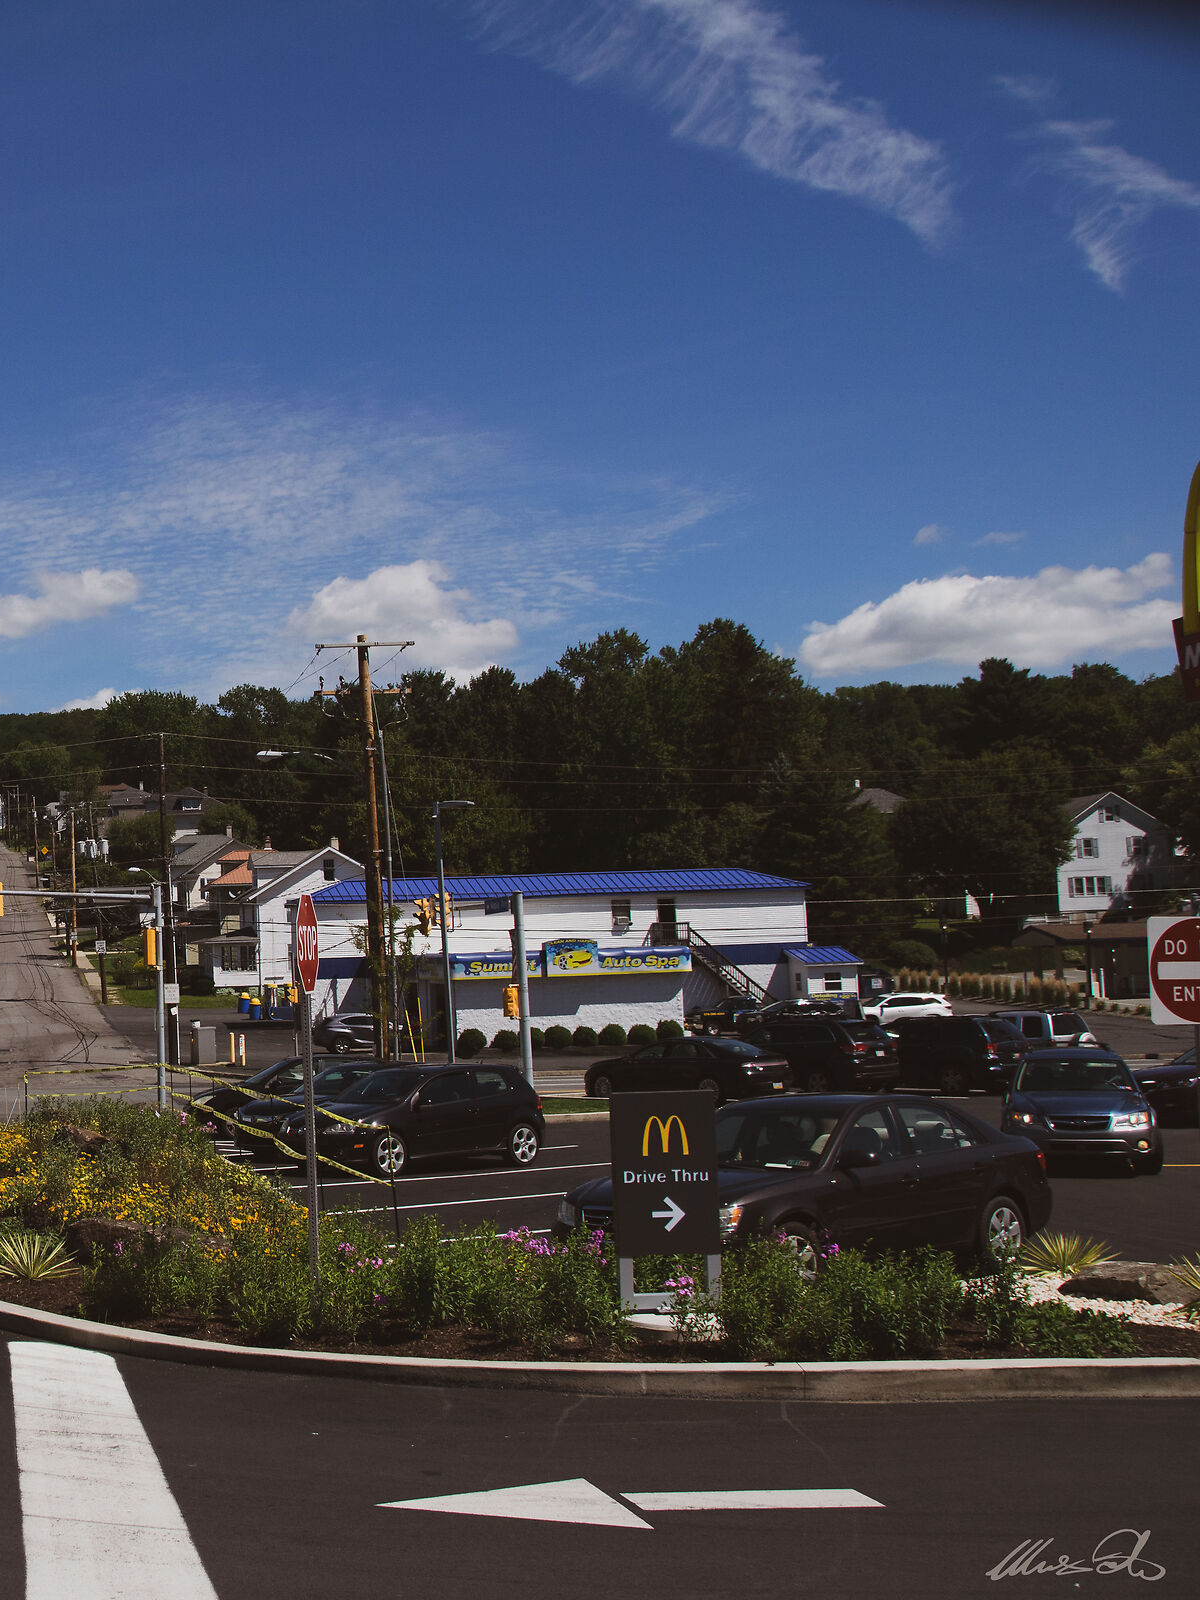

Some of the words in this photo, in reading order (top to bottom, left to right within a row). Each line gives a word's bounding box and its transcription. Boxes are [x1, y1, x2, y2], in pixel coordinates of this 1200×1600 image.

[298, 925, 317, 961] STOP
[1164, 939, 1187, 955] DO
[469, 959, 537, 973] Sumit
[601, 955, 643, 968] Auto
[645, 955, 680, 969] Spa
[623, 1170, 667, 1184] Drive
[671, 1169, 709, 1182] Thru
